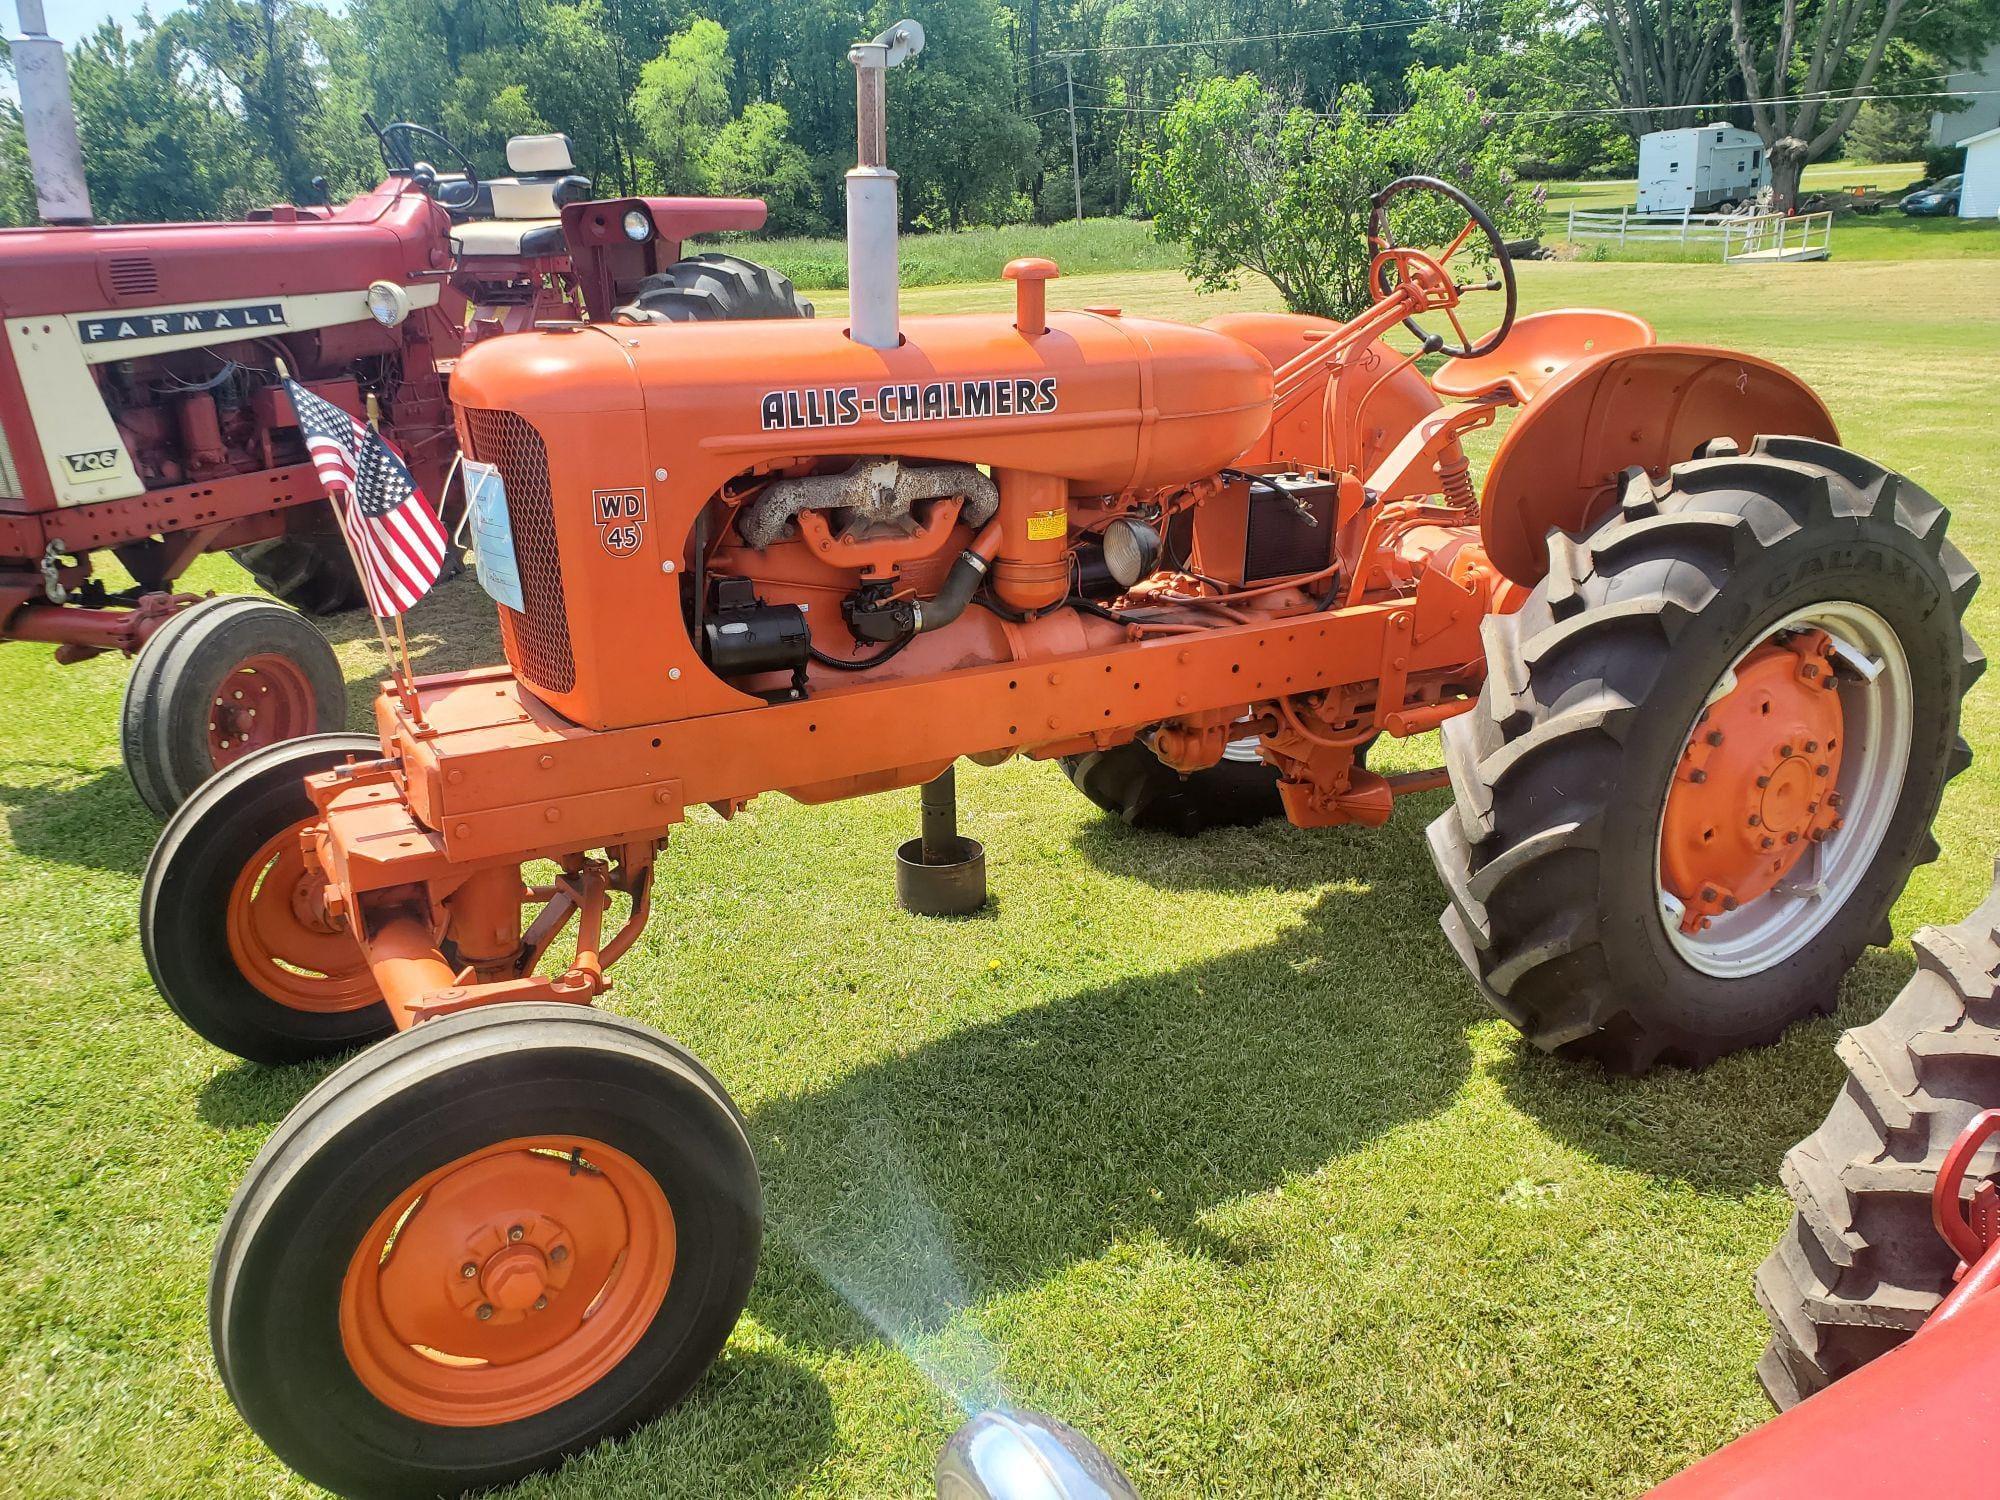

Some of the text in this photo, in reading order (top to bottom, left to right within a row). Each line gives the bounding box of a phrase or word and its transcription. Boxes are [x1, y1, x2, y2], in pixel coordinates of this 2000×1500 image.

[87, 308, 283, 340] FARMALL
[760, 377, 1058, 430] ALLIS-CHALMERS
[71, 451, 116, 471] 706
[600, 494, 641, 519] WD
[607, 526, 638, 550] 45
